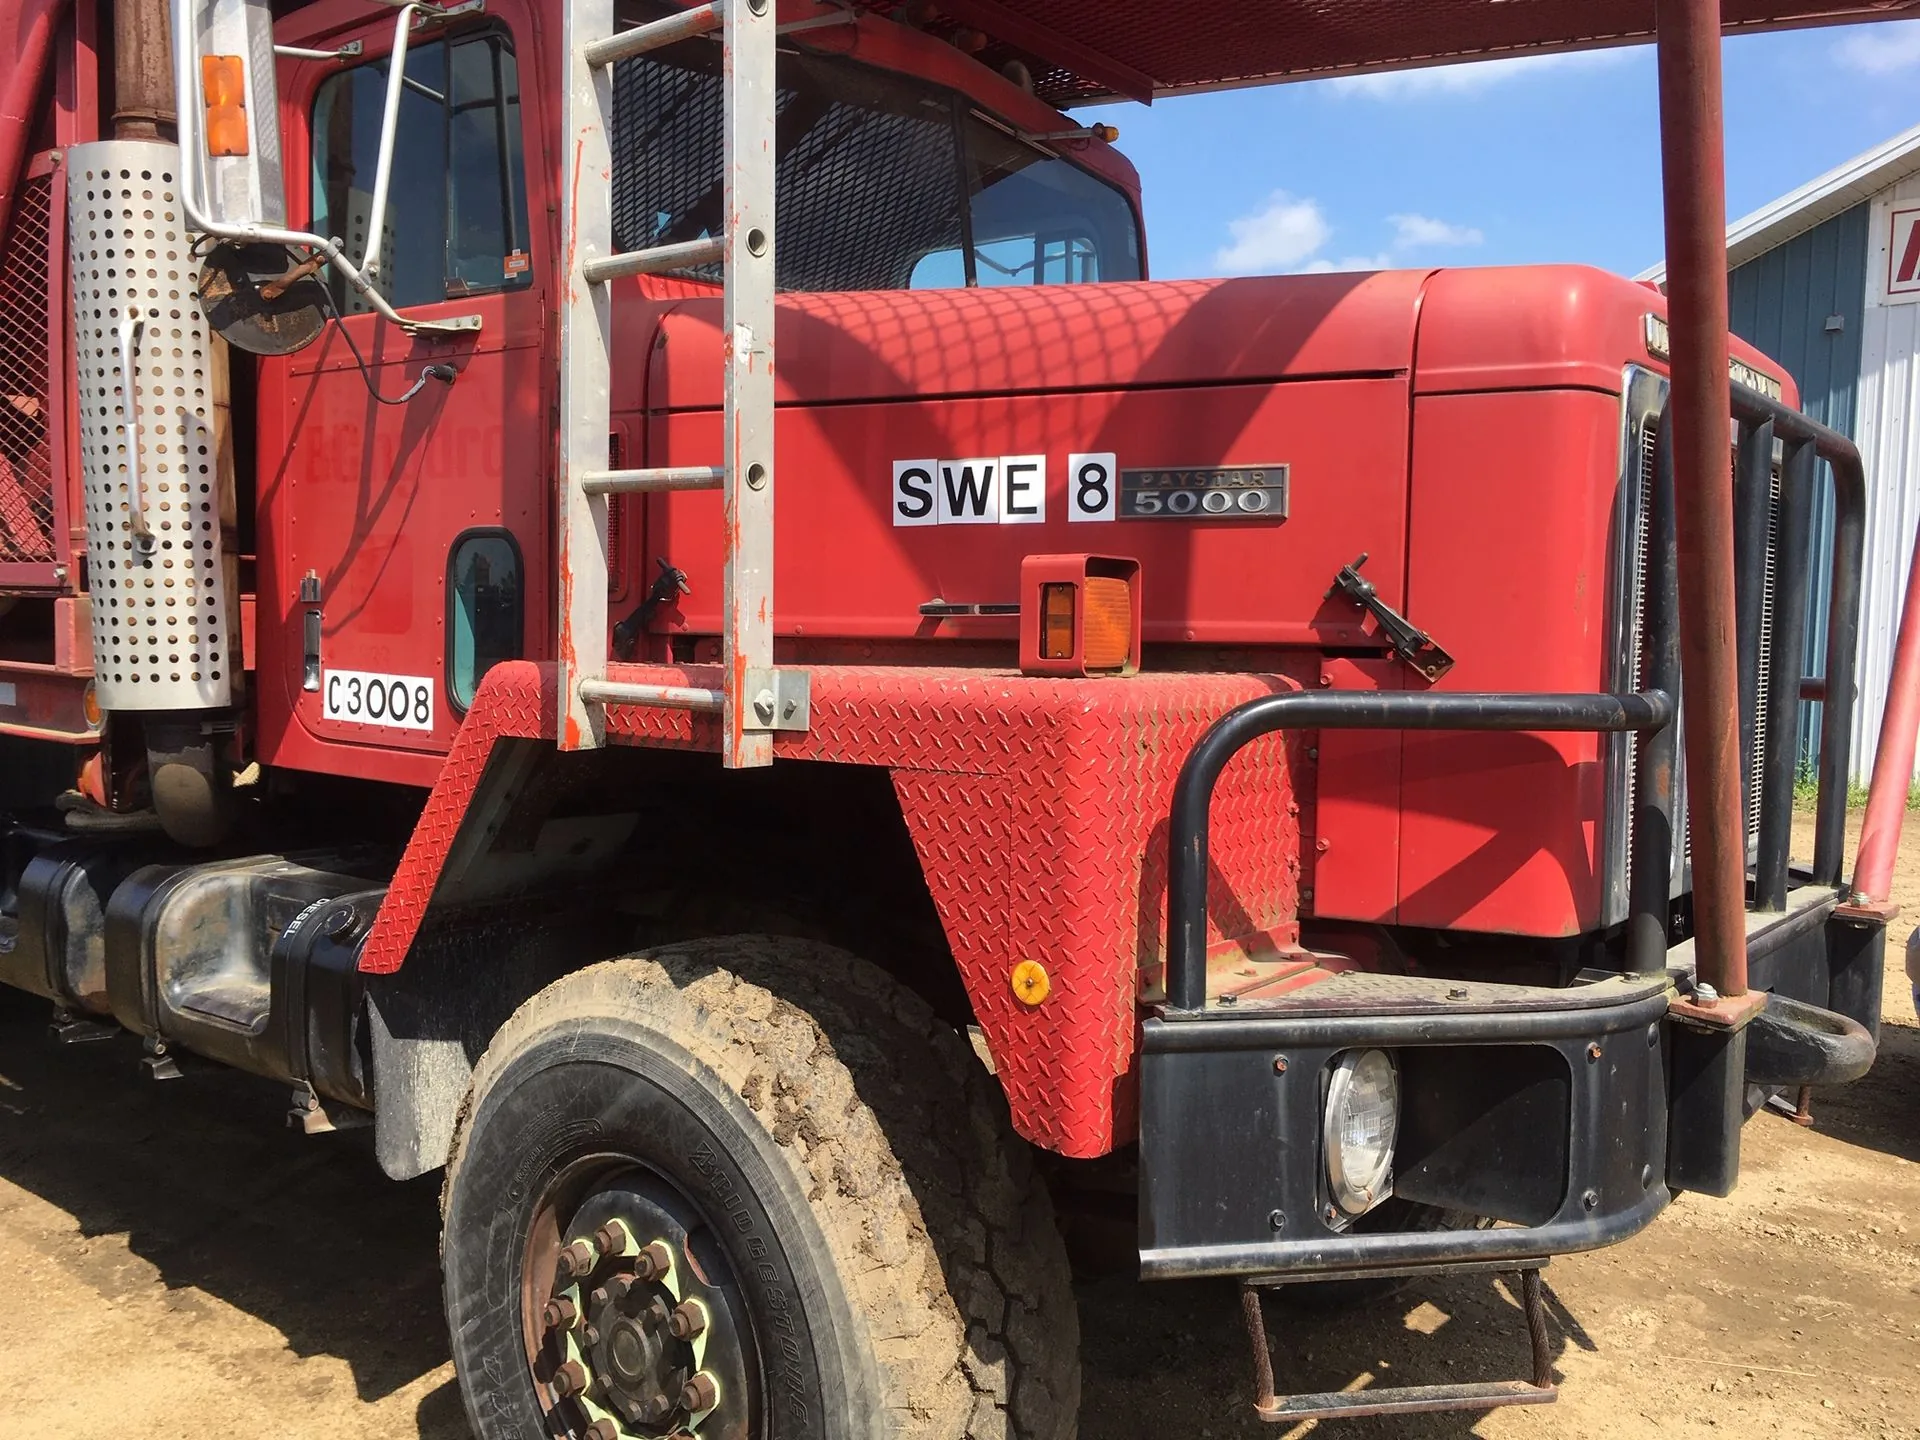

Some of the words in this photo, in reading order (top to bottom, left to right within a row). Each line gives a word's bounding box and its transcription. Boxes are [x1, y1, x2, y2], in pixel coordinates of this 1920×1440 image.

[896, 463, 1039, 519] SWE
[1076, 462, 1110, 515] 8
[1140, 470, 1266, 488] PAYSTAR
[1134, 489, 1271, 514] 5000
[327, 675, 430, 725] C3008
[282, 898, 331, 939] DIESEL
